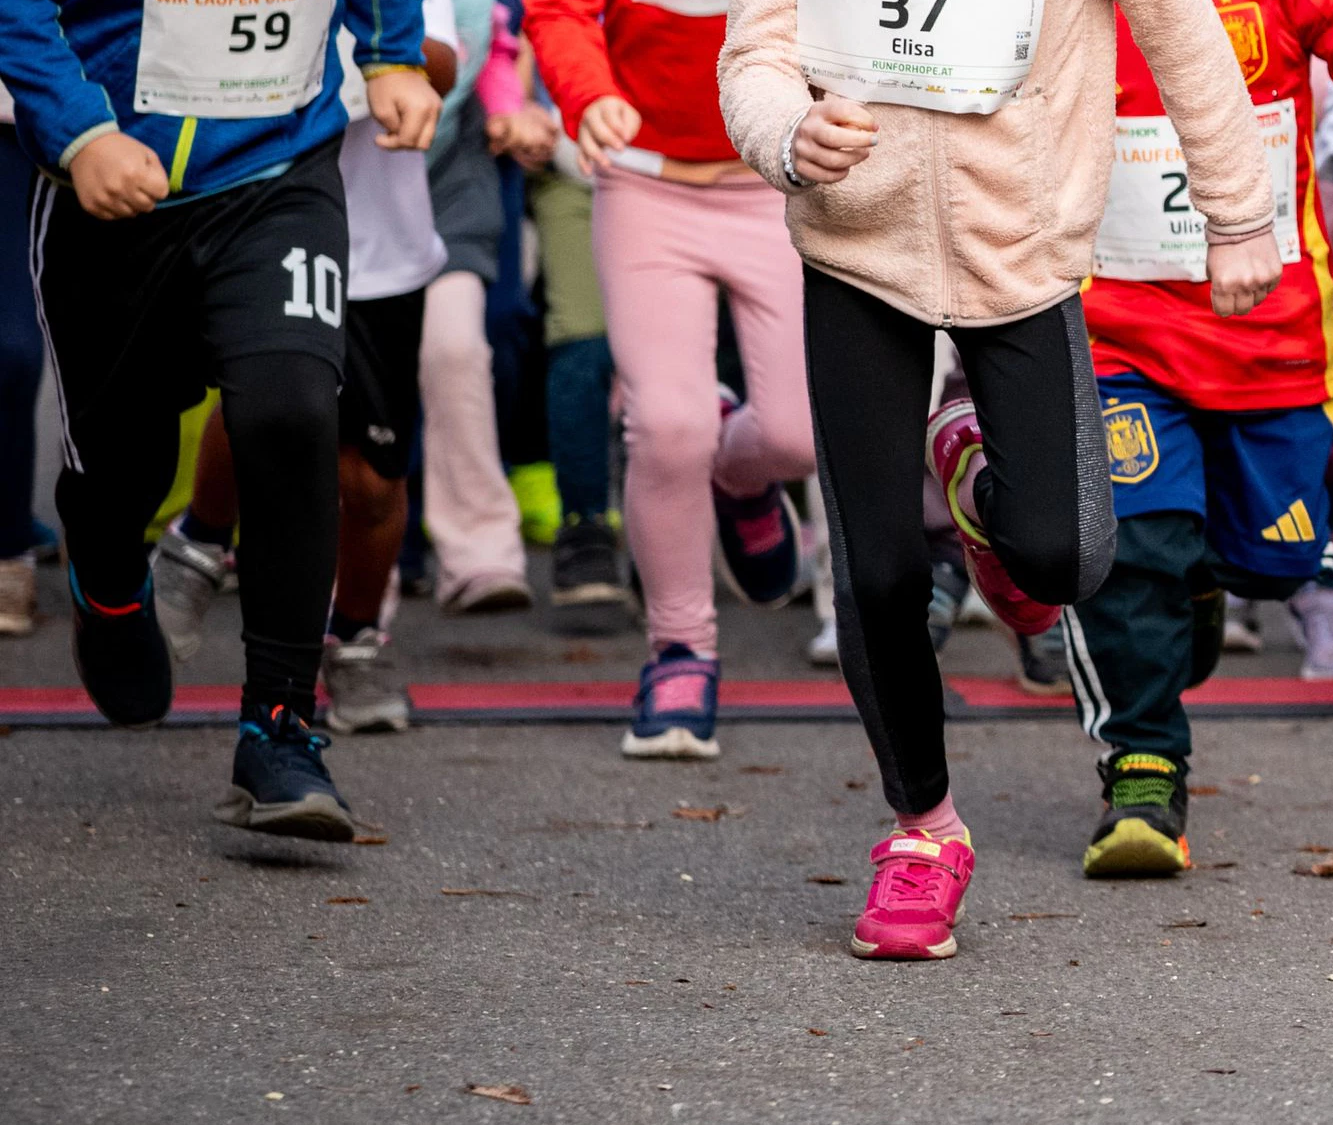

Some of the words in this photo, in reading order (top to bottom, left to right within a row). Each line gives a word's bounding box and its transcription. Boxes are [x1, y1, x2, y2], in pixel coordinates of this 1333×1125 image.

[228, 10, 291, 53] 59
[892, 38, 934, 57] Elisa
[872, 60, 953, 76] RUNFORHOPE.AT
[1161, 172, 1190, 213] 2
[1170, 220, 1207, 235] Ulis
[281, 247, 342, 328] 10
